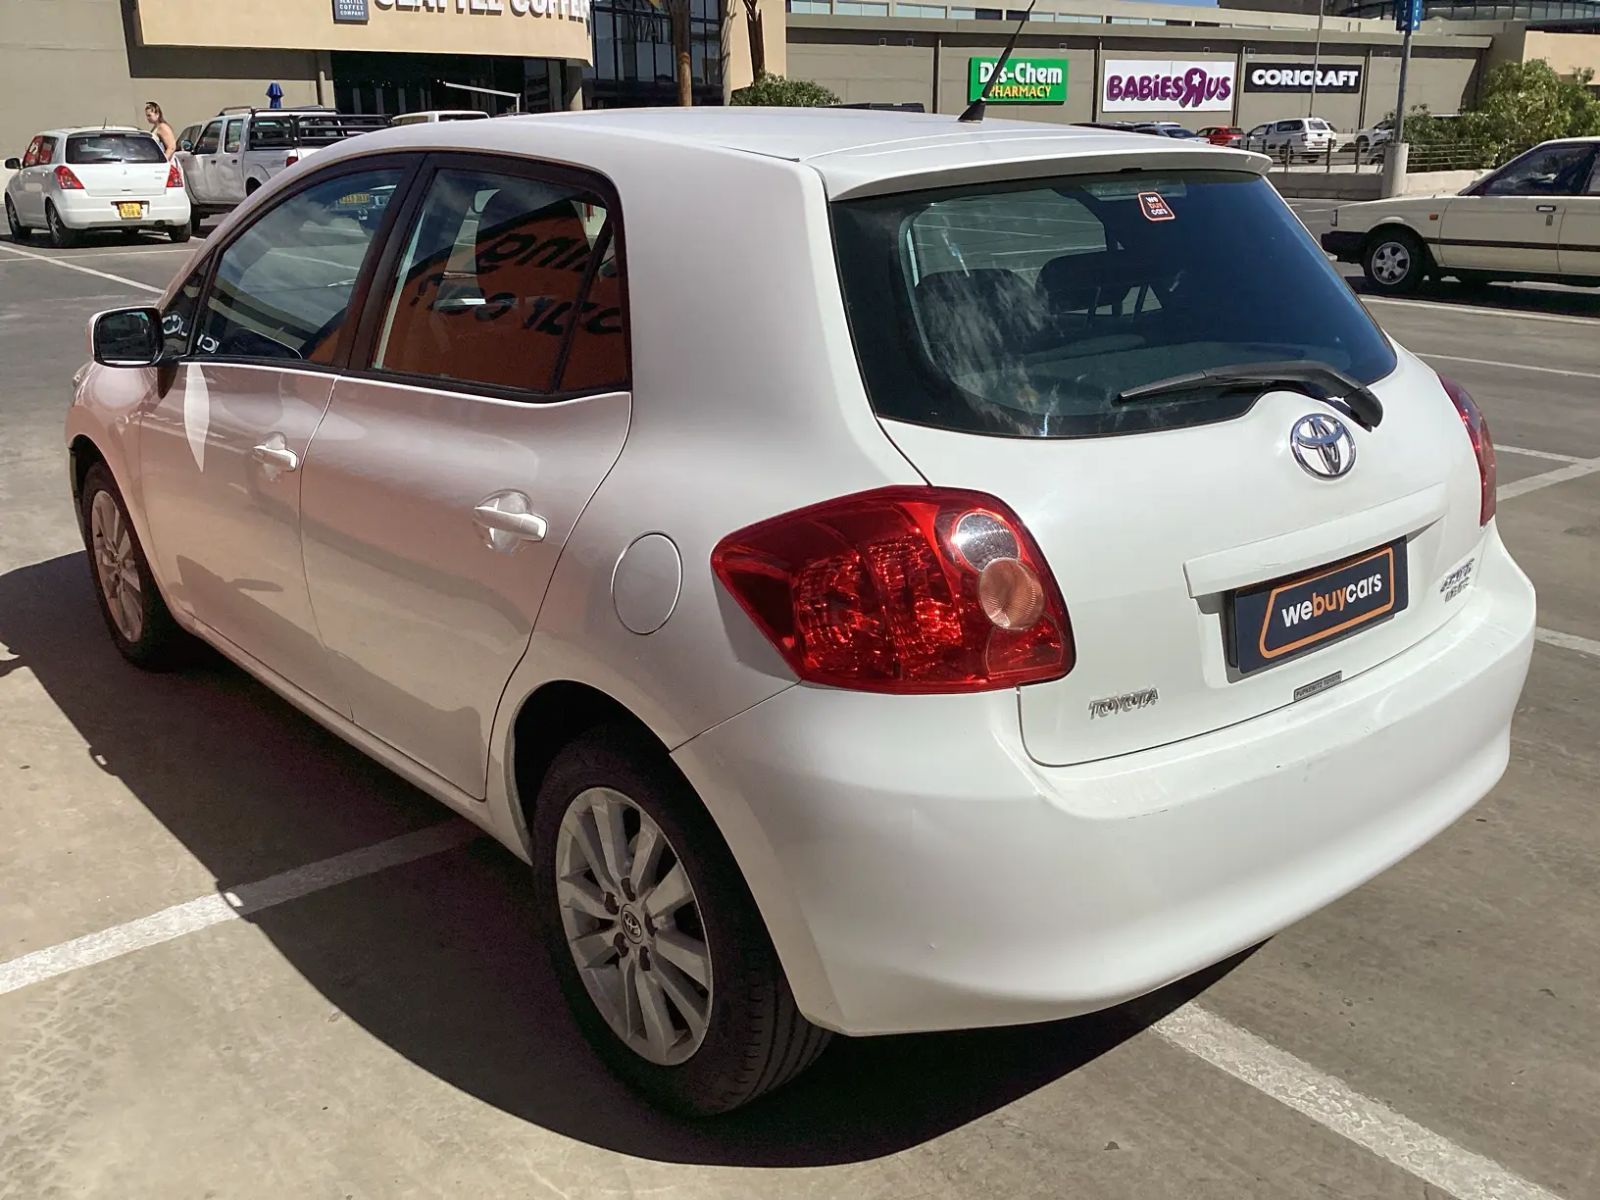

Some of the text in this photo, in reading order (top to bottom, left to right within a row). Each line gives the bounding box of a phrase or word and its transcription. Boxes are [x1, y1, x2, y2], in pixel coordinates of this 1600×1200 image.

[1251, 68, 1359, 87] CORICRAFT
[1282, 573, 1382, 628] webuycars
[1088, 688, 1158, 720] TOYOTA
